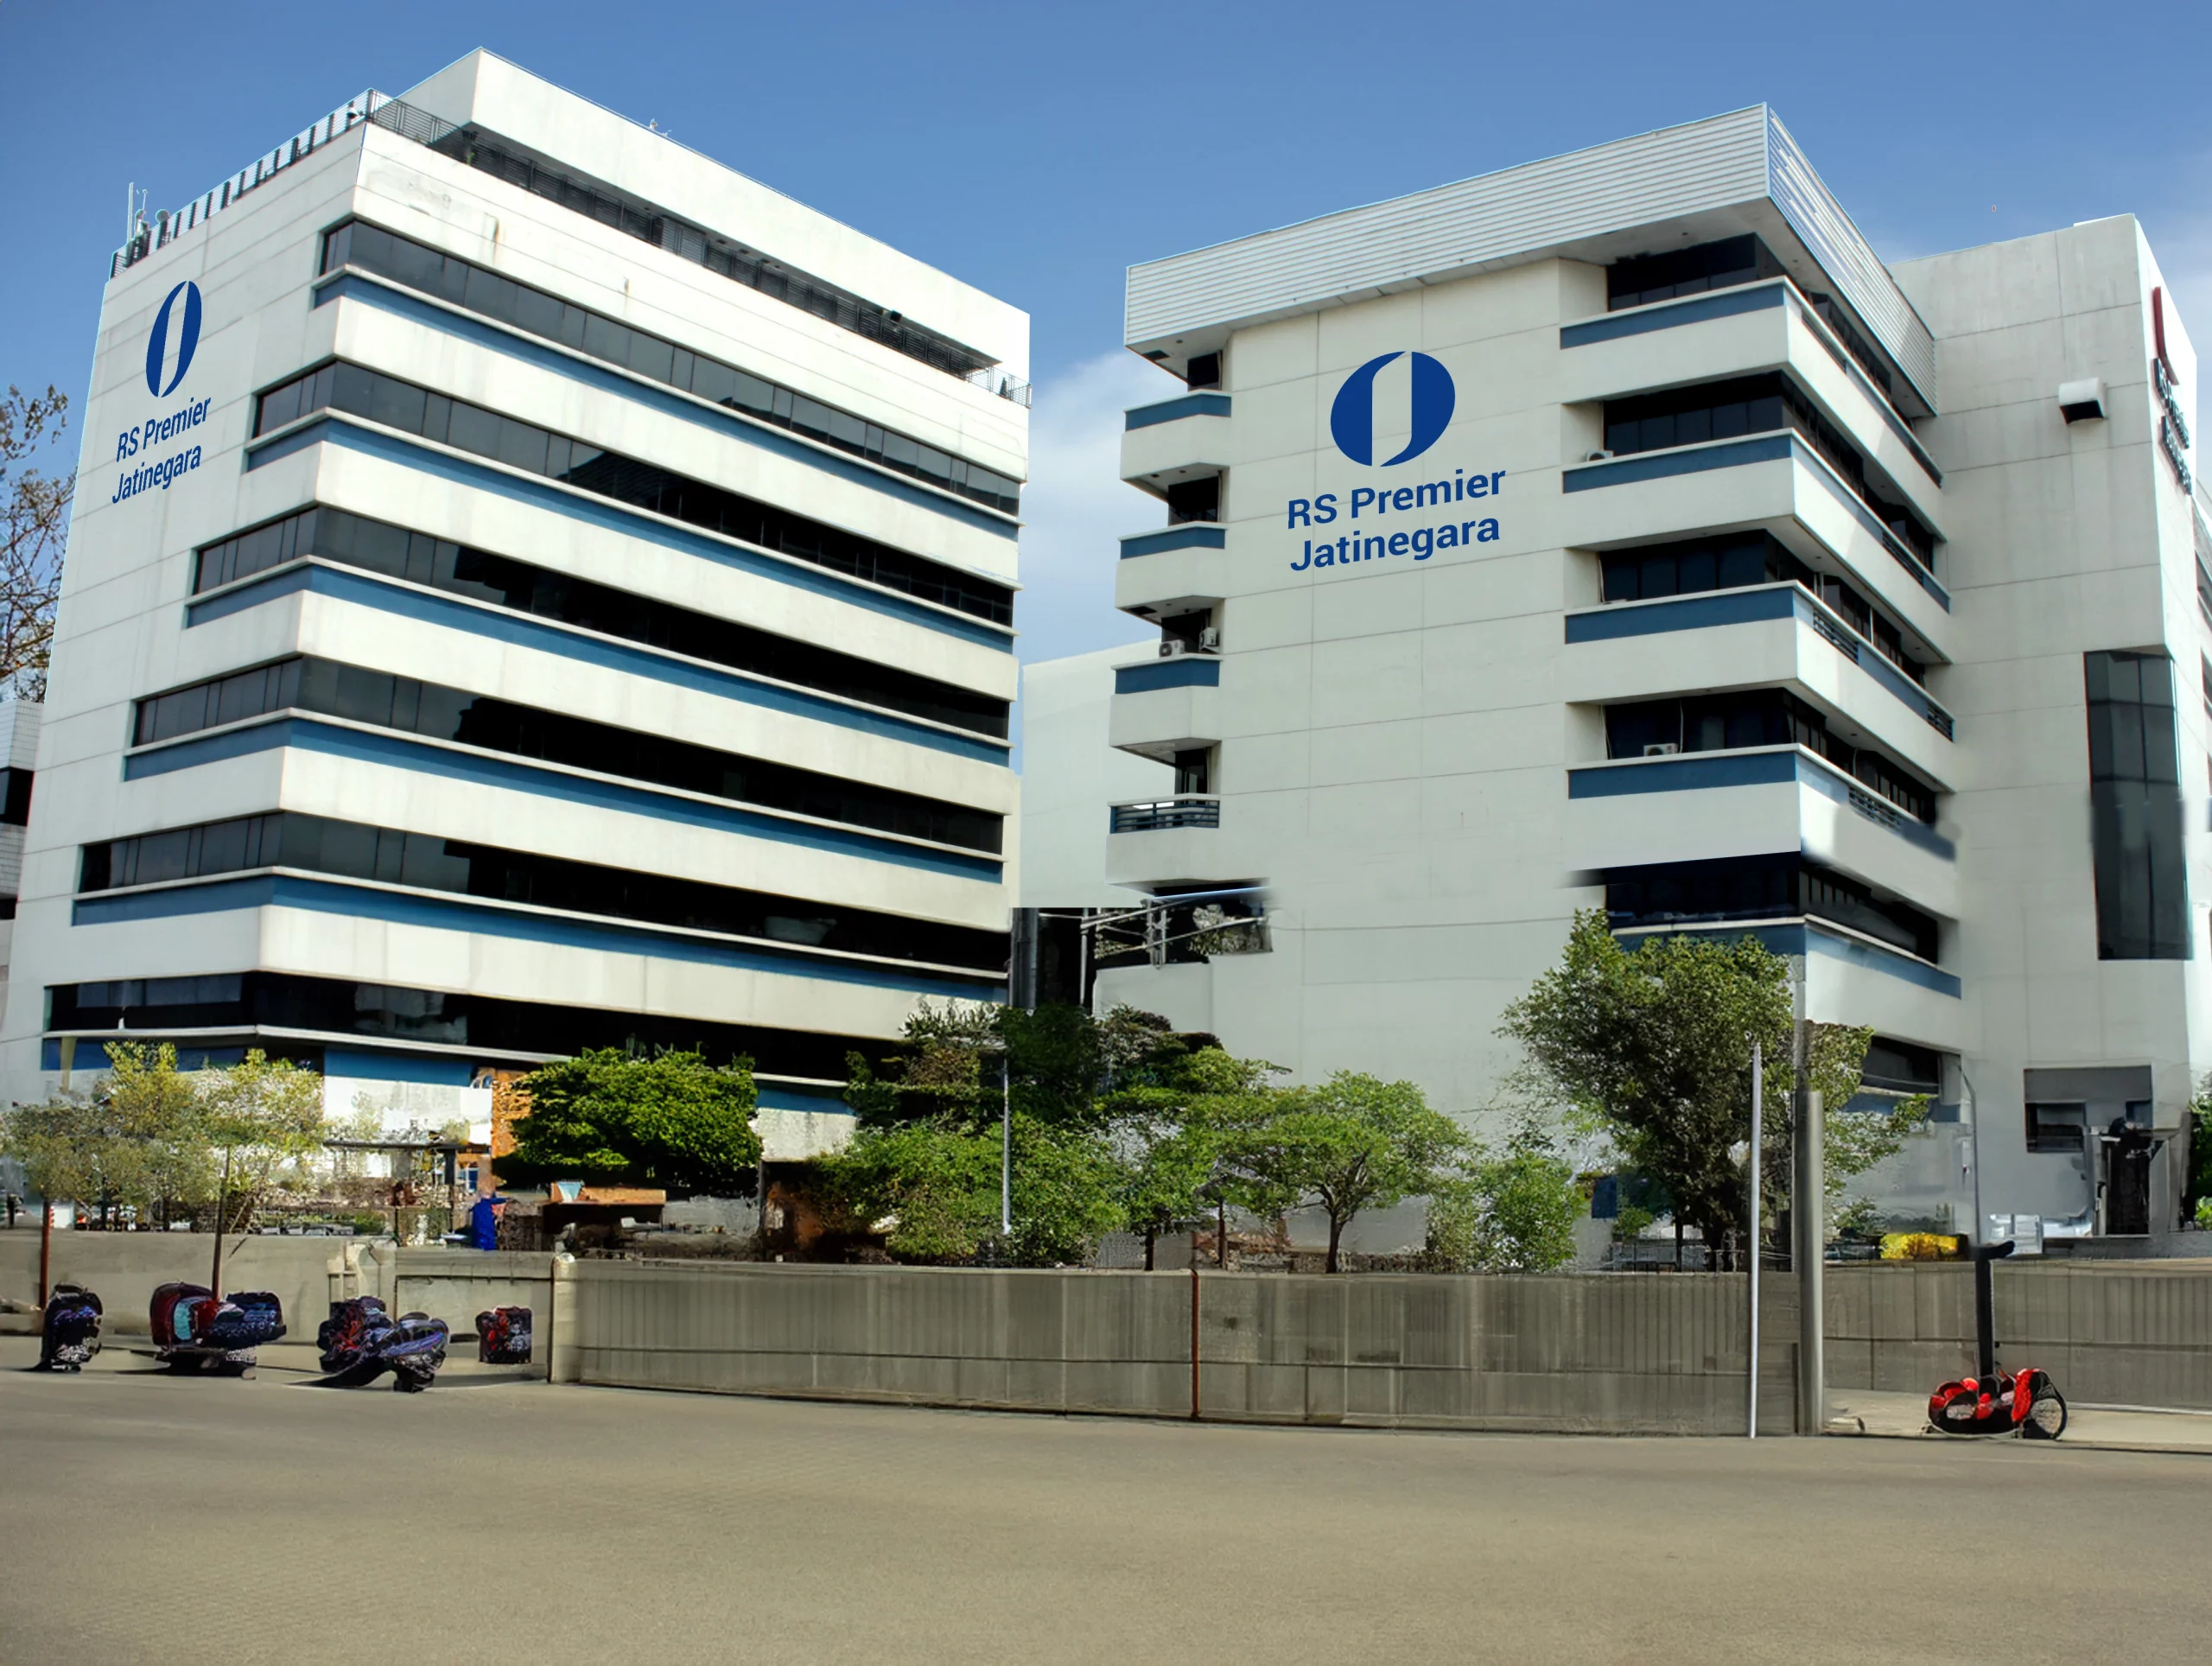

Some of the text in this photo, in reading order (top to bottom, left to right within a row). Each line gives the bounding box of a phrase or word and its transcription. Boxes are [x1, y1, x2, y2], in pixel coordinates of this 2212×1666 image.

[116, 397, 212, 462] RS Premier
[111, 445, 201, 504] Jatinegara
[1288, 468, 1505, 529] RS Premier
[1290, 518, 1500, 571] Jatinegara
